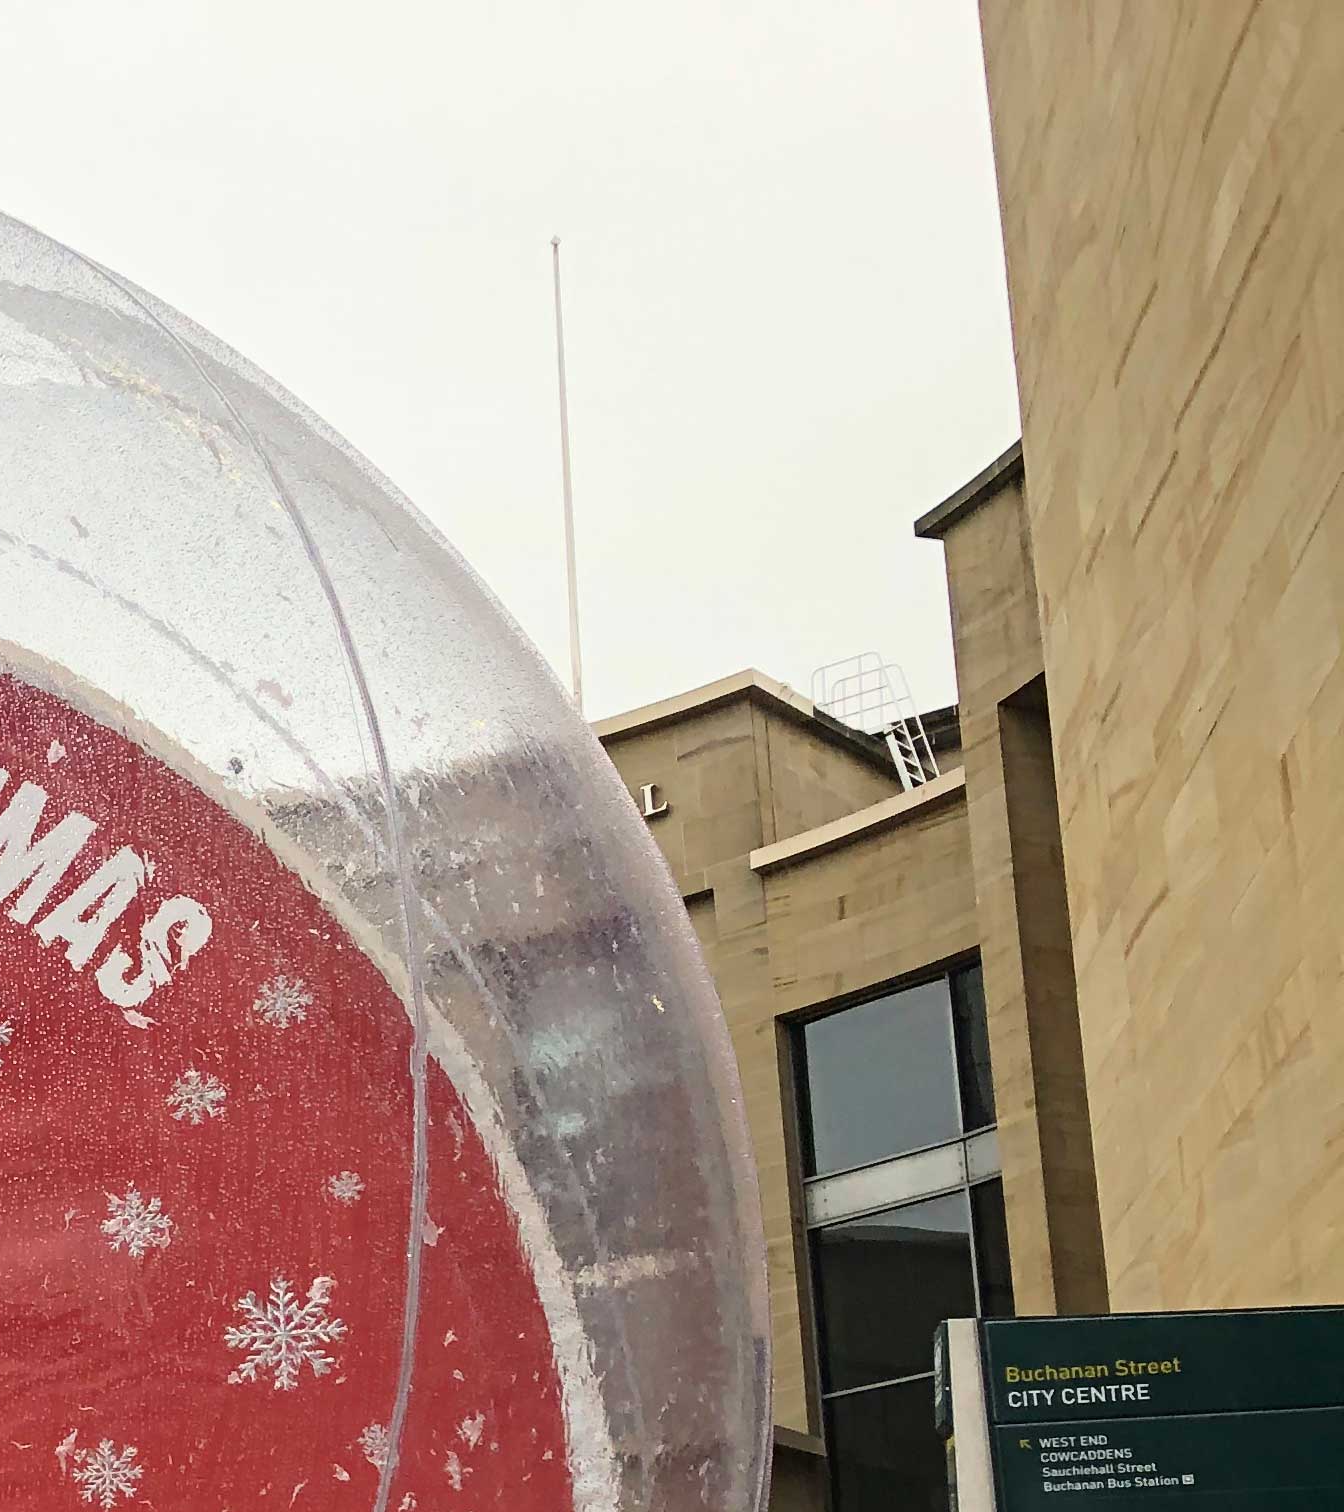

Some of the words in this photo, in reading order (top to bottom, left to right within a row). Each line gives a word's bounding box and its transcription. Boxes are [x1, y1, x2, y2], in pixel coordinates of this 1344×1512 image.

[1006, 1364, 1109, 1383] Buchanan
[1115, 1357, 1182, 1377] Street
[1008, 1389, 1055, 1408] CITY
[1061, 1384, 1150, 1405] CENTRE
[1039, 1436, 1076, 1449] WEST
[1080, 1435, 1108, 1447] END
[1040, 1448, 1132, 1463] COWCADDENS
[1042, 1464, 1114, 1478] Sauchiehall
[1117, 1462, 1157, 1474] Street
[1043, 1480, 1104, 1493] Buchanan
[1107, 1477, 1132, 1489] Bus
[1134, 1475, 1179, 1488] Station
